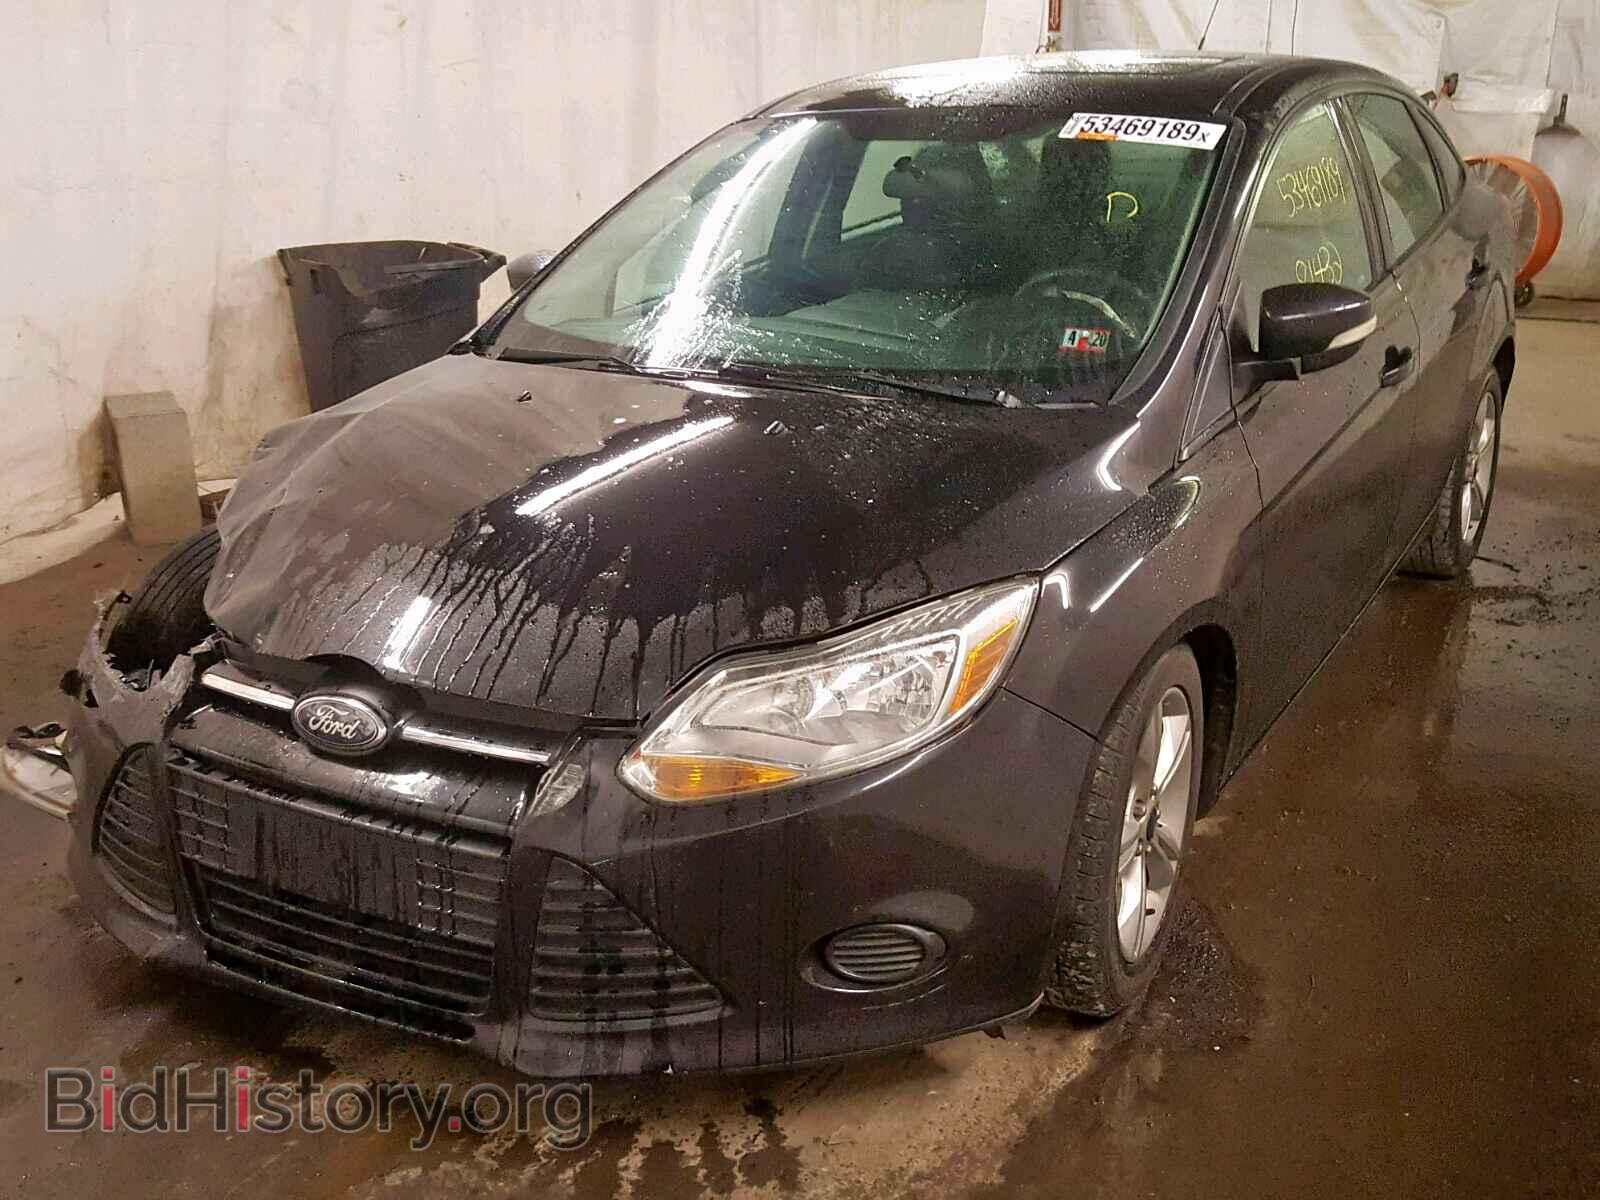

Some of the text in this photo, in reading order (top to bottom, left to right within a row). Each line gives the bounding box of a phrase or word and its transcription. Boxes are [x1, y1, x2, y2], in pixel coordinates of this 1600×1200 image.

[1080, 114, 1200, 142] 53469189
[1067, 330, 1108, 347] 4 20
[309, 704, 361, 739] Ford
